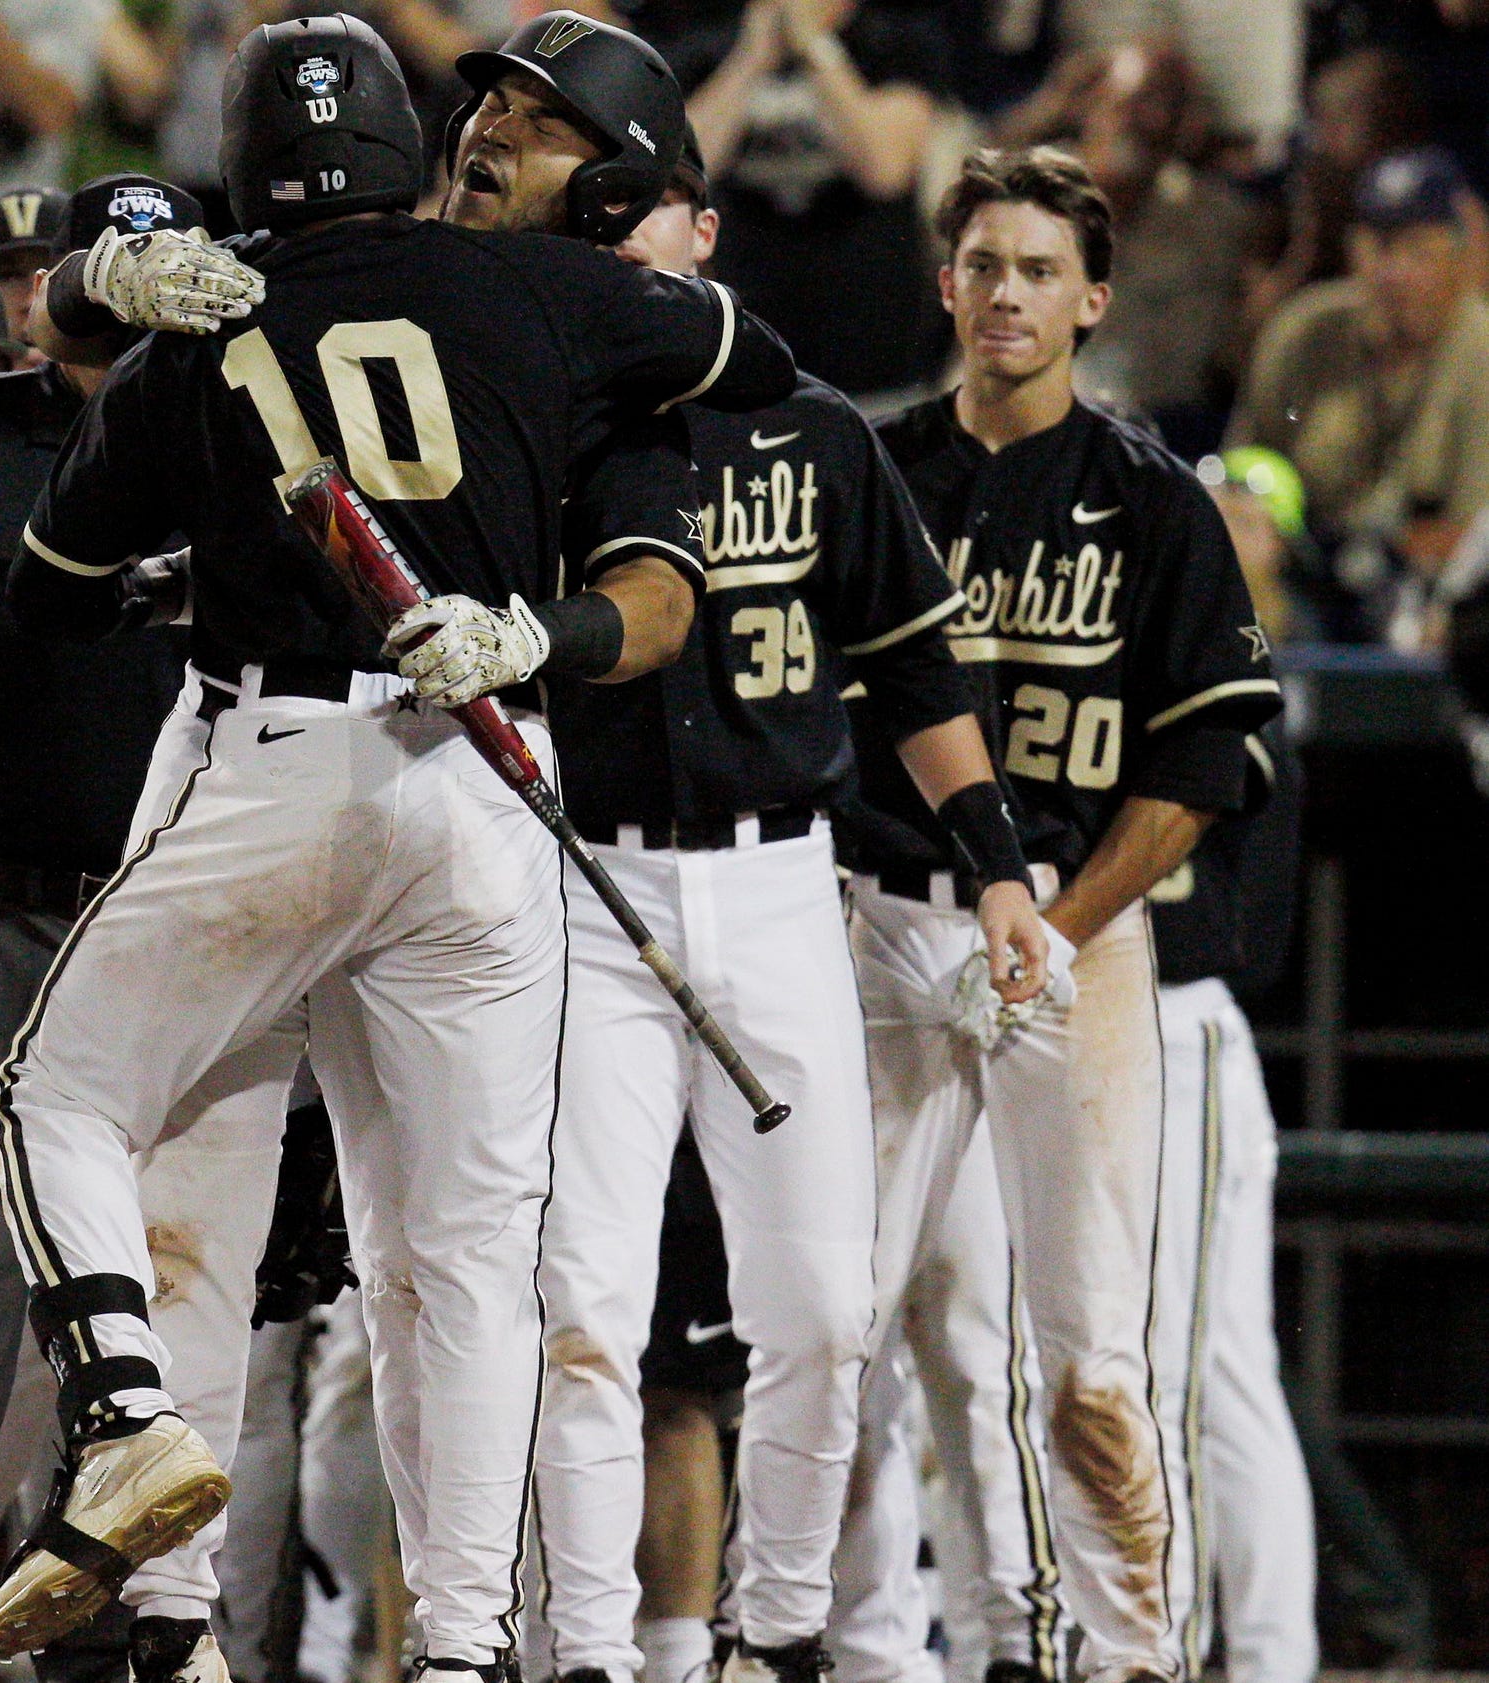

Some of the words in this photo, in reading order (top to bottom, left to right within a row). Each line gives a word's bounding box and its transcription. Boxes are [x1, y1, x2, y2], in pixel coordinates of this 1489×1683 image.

[535, 16, 596, 58] V
[297, 68, 338, 84] CWS
[628, 119, 656, 155] Wilson
[319, 169, 346, 192] 10
[0, 194, 42, 238] V
[107, 195, 173, 219] CWS
[220, 318, 464, 515] 10
[731, 599, 816, 700] 39
[1005, 683, 1123, 790] 20
